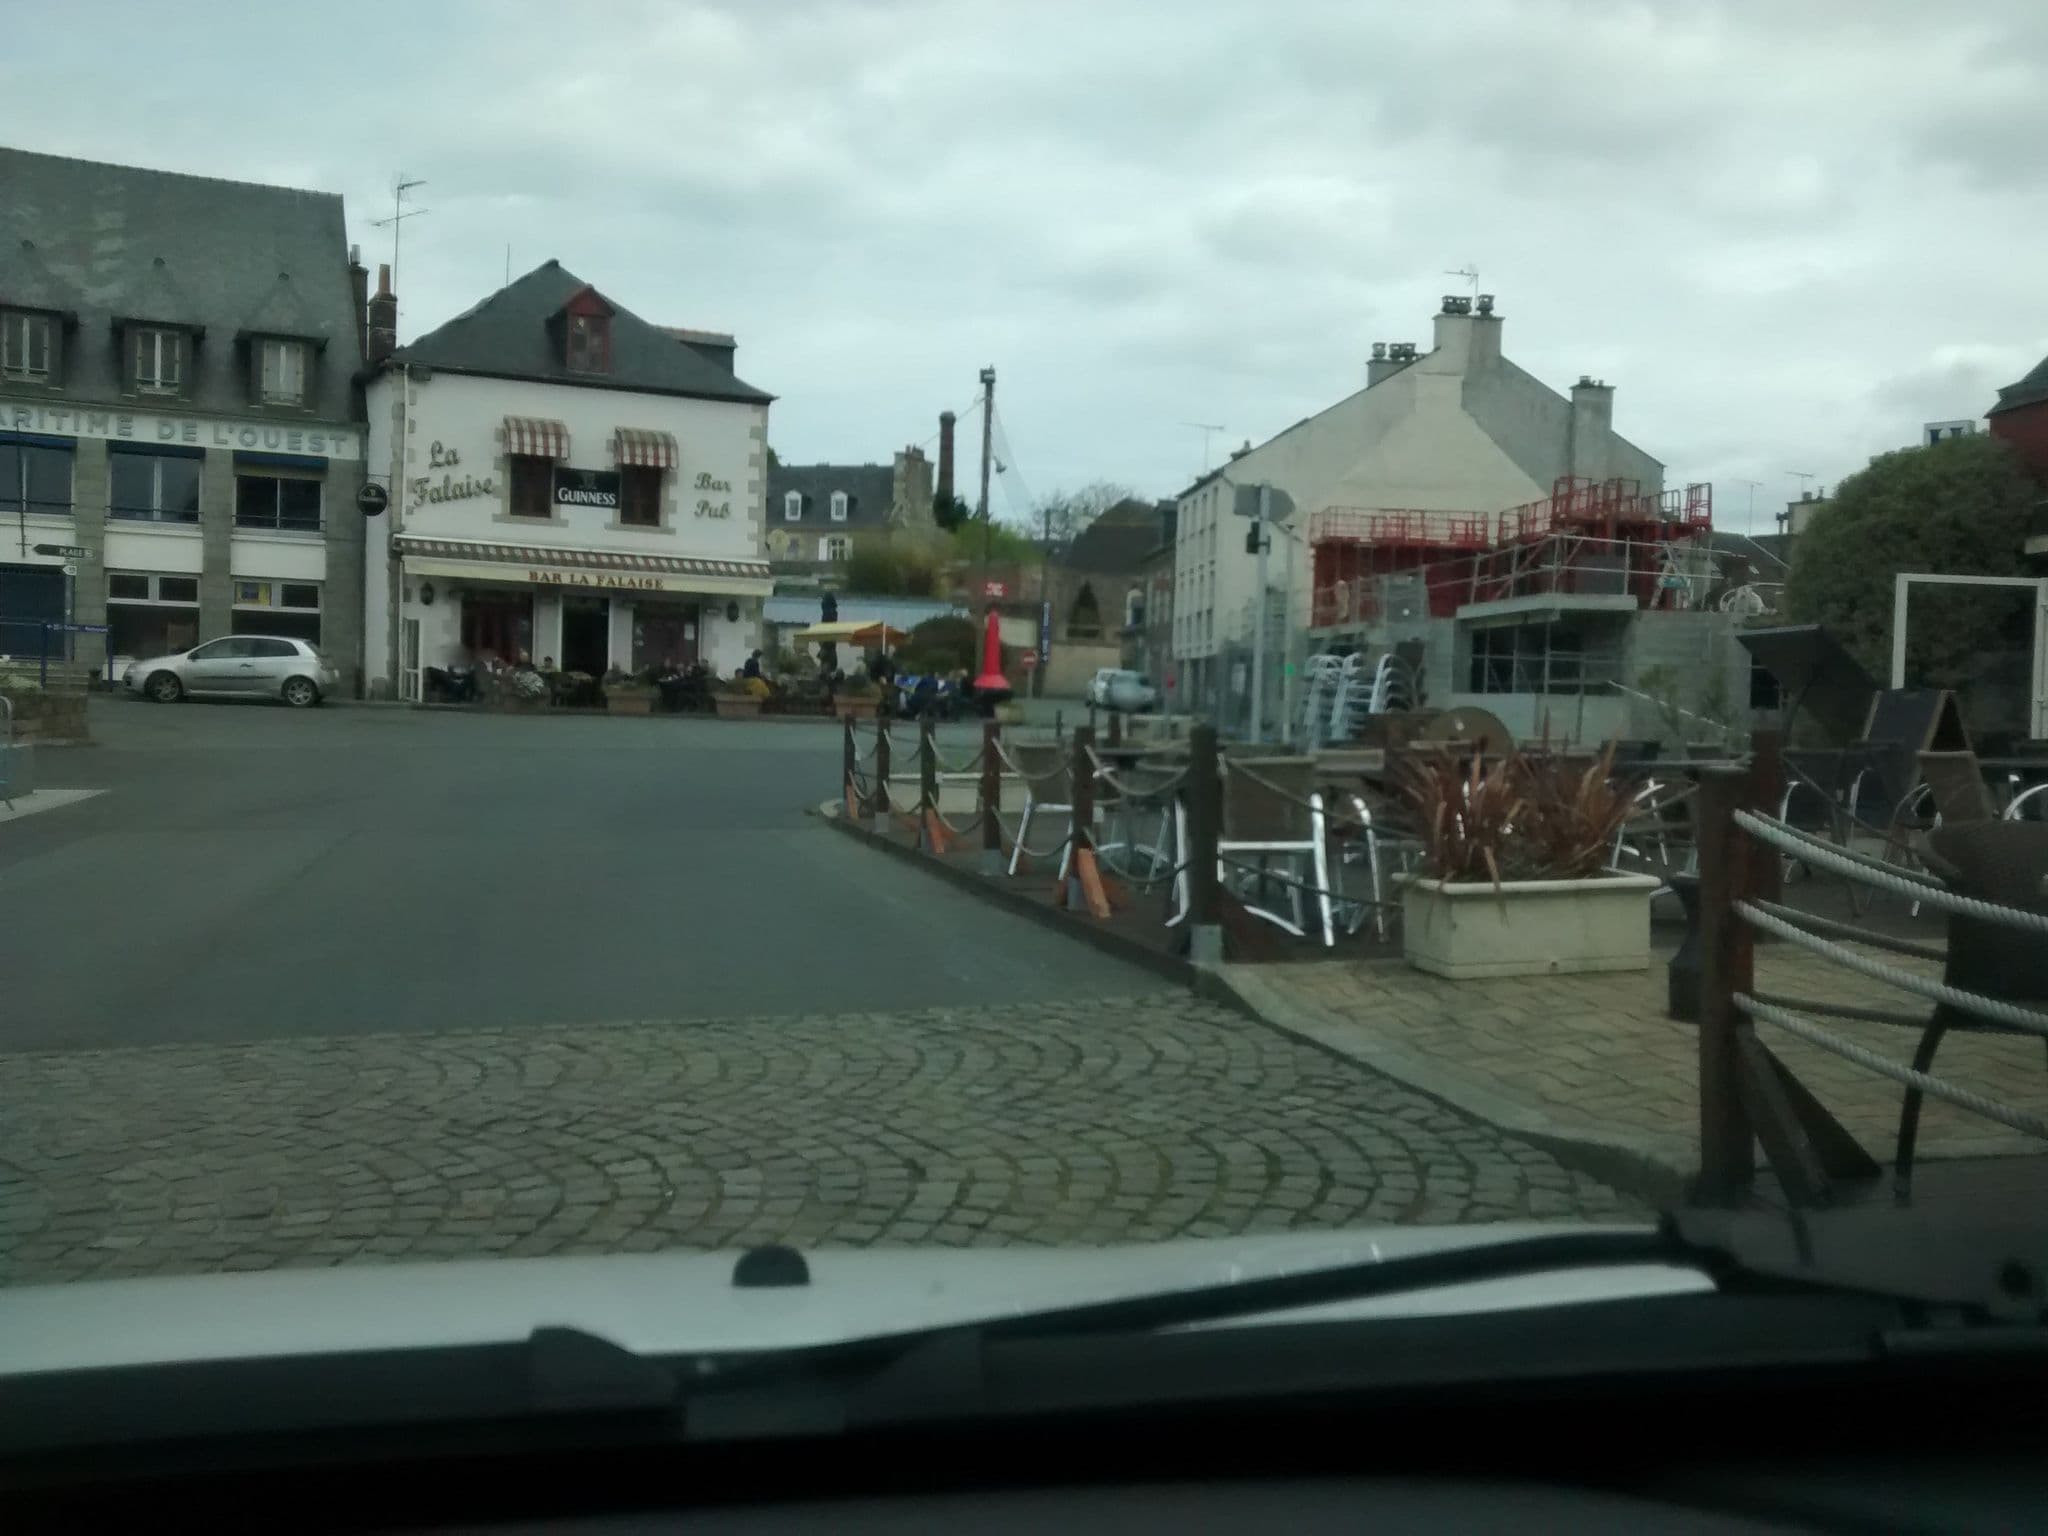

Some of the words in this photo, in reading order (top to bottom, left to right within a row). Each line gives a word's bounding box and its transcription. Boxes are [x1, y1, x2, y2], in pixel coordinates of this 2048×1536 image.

[157, 421, 198, 442] DE
[213, 426, 348, 454] L'OUEST
[428, 440, 460, 469] La
[412, 474, 495, 508] Falaise
[694, 472, 732, 493] Bar
[558, 487, 617, 506] GUINNESS
[693, 500, 731, 520] Pub
[529, 571, 562, 585] BAR
[570, 573, 592, 587] LA
[596, 575, 664, 590] FALAISE
